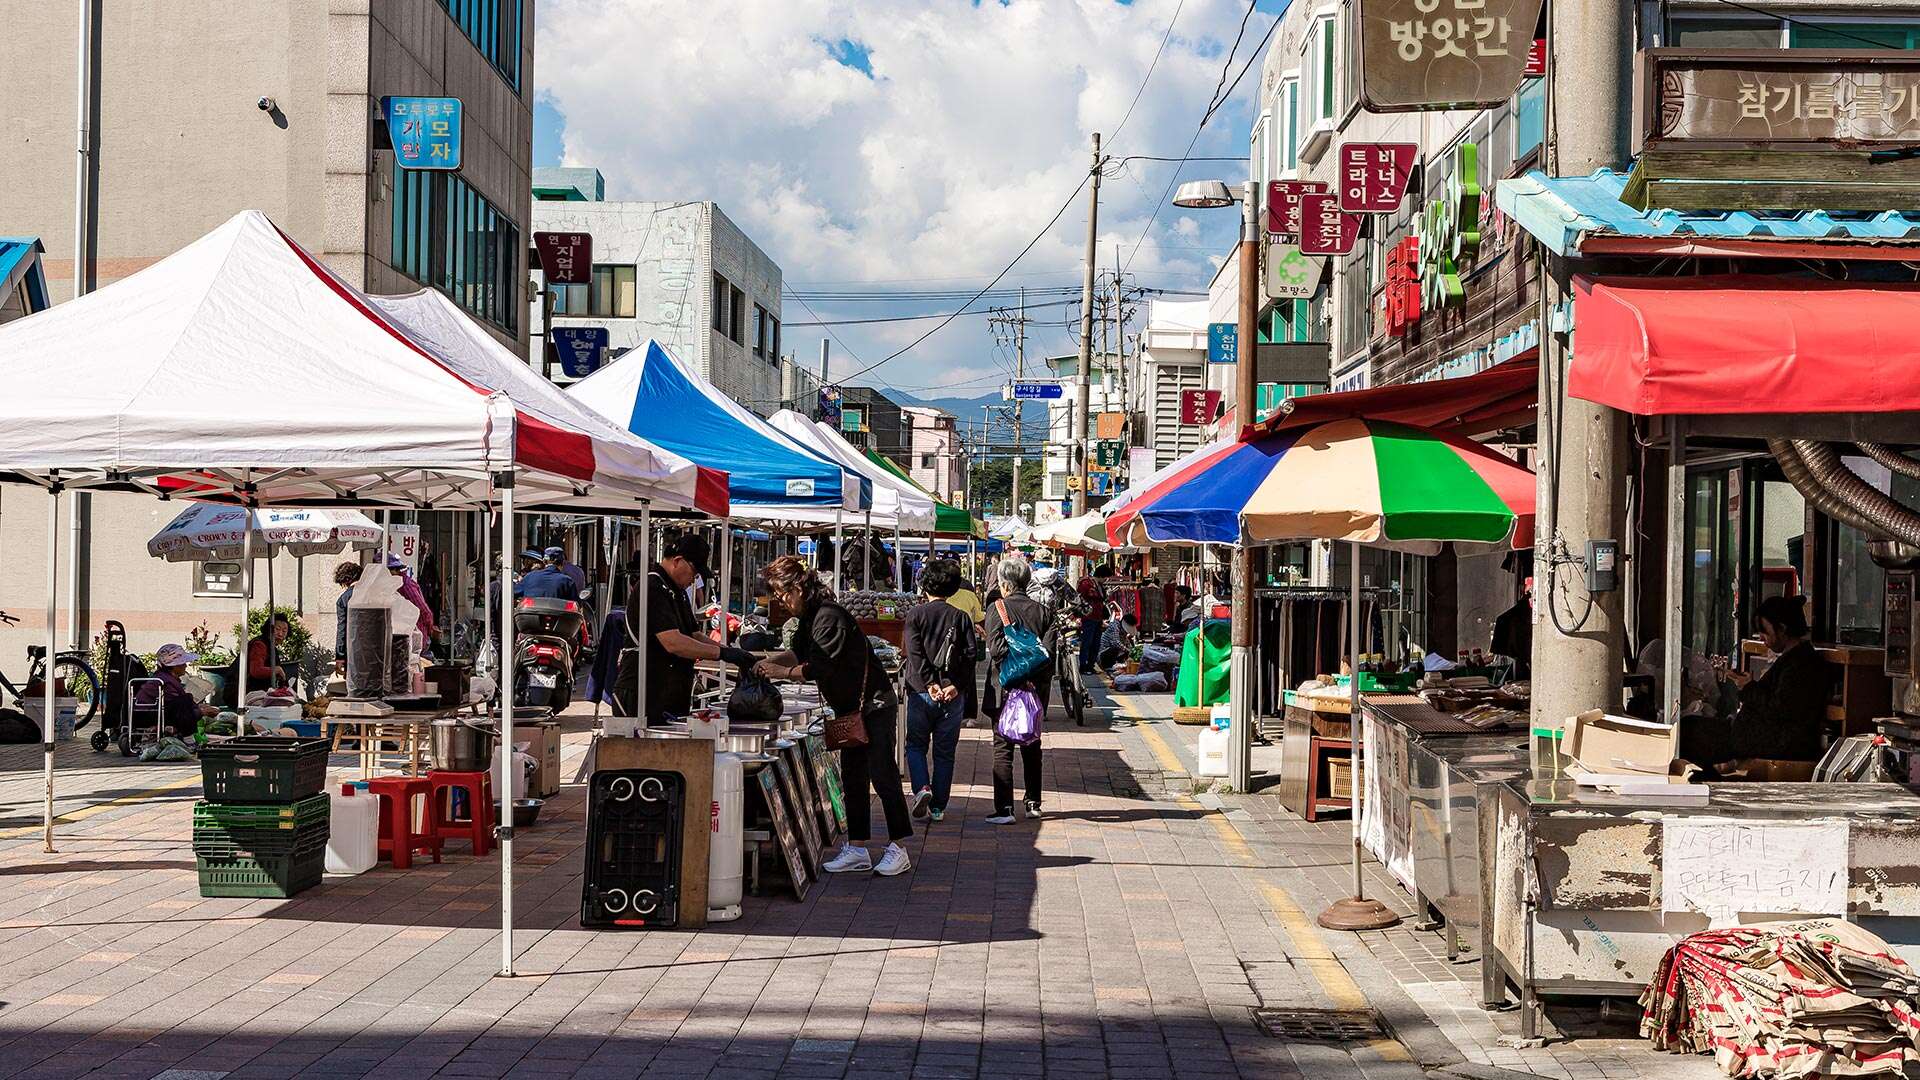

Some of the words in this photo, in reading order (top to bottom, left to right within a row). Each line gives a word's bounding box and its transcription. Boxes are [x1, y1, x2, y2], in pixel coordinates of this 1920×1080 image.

[1390, 17, 1512, 62] 방앗간
[1737, 83, 1834, 119] 참기름
[430, 121, 451, 160] 모자
[1348, 150, 1368, 204] 트라이
[1377, 150, 1396, 203] 비너스
[1319, 199, 1342, 250] 원일전기
[556, 246, 575, 281] 지업사
[1279, 285, 1309, 296] 꼬망스
[197, 531, 228, 543] CROWN
[1678, 869, 1761, 897] 무단투기
